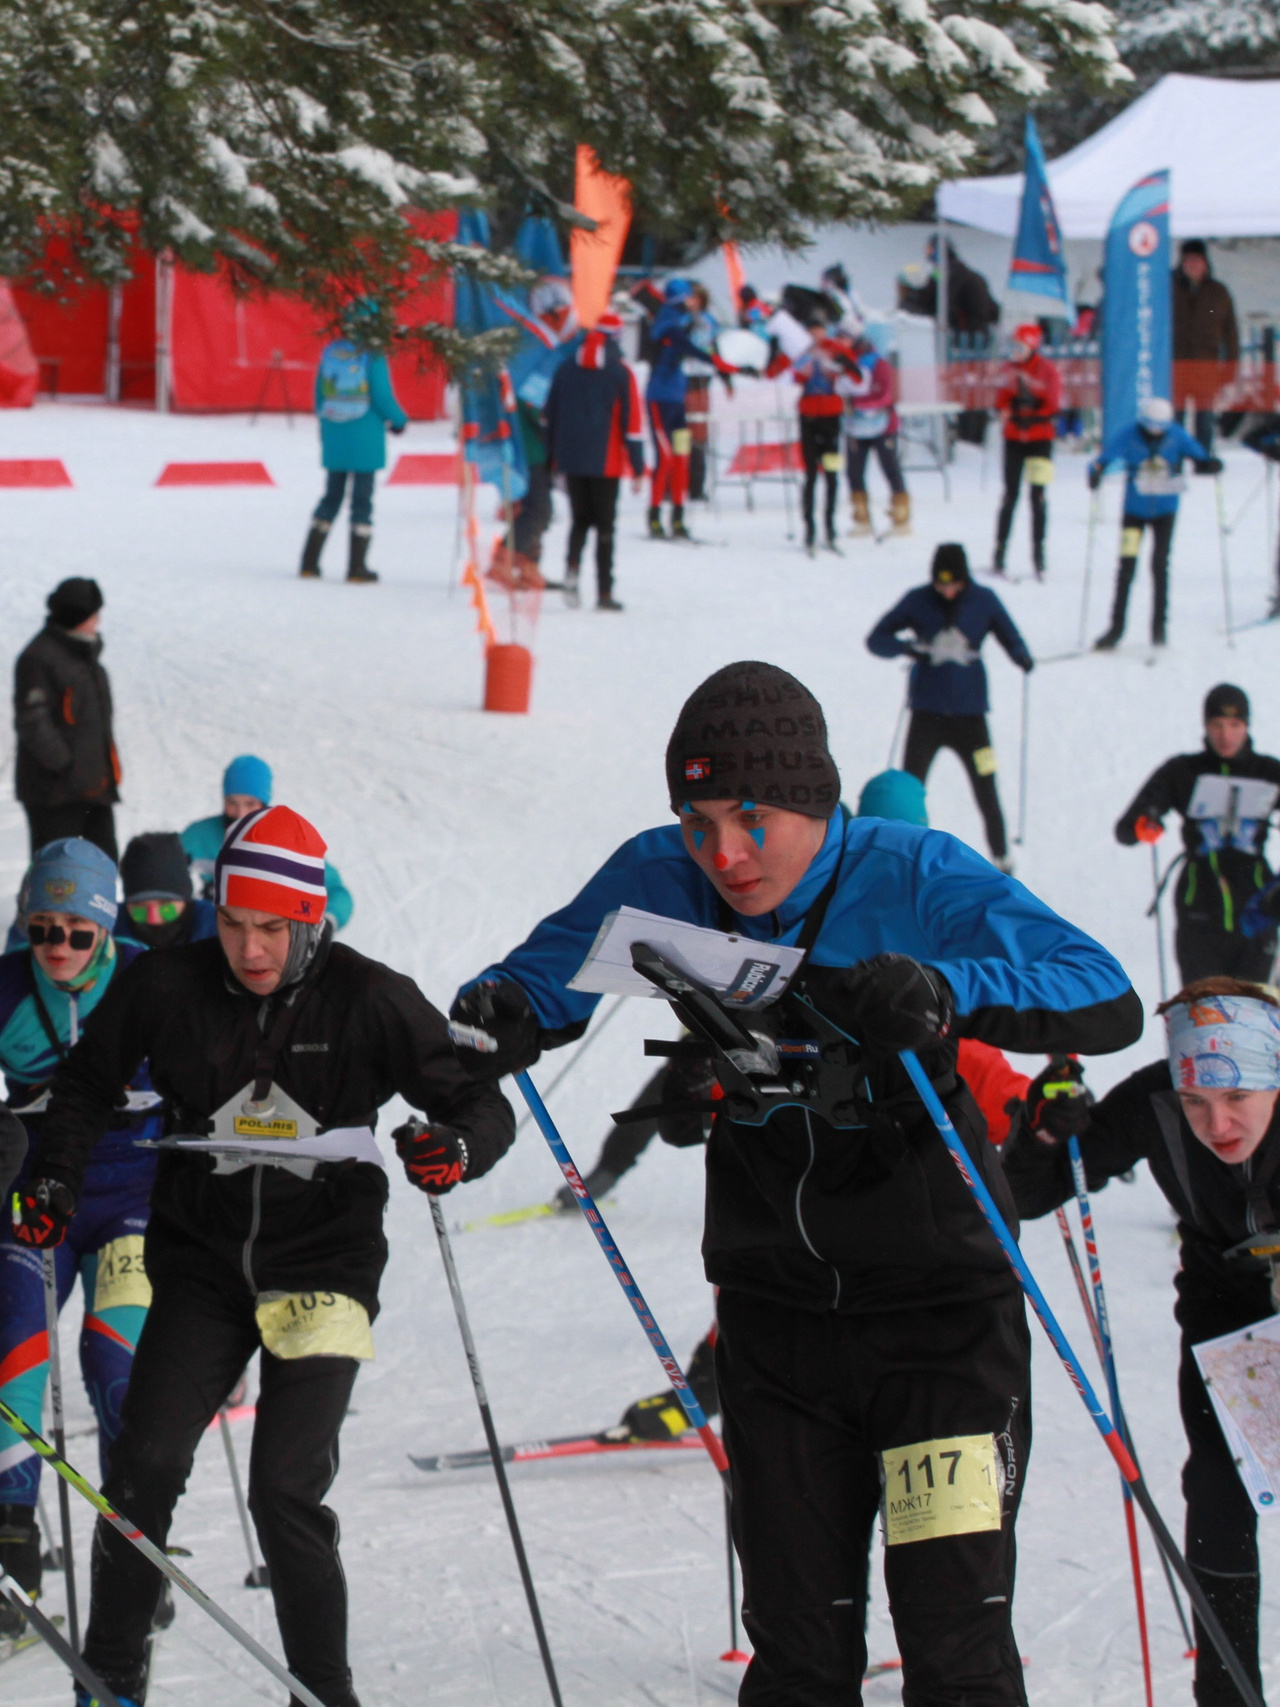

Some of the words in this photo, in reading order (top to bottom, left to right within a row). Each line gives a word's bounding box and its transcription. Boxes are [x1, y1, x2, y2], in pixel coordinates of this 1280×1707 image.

[897, 1449, 962, 1494] 117
[981, 1464, 992, 1486] 1
[890, 1493, 932, 1516] МЖ17
